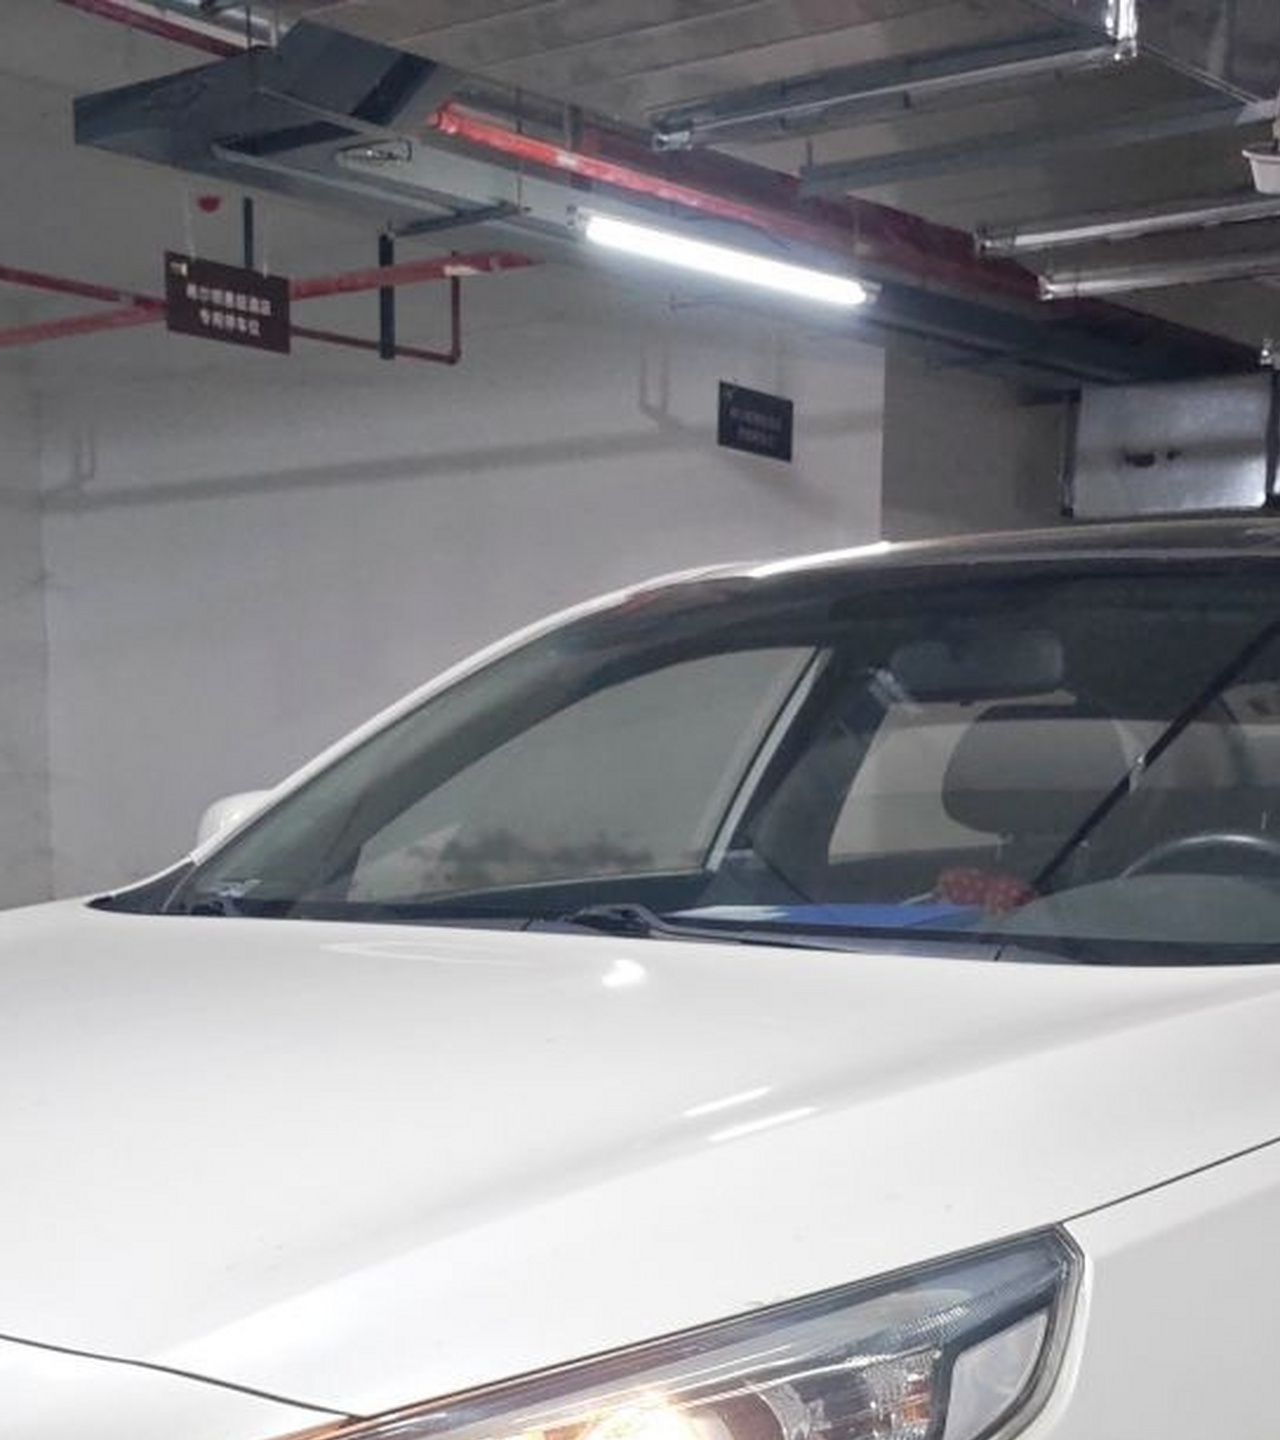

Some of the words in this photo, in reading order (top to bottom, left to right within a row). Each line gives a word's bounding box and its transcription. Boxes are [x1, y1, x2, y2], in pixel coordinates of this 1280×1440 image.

[199, 308, 261, 338] 专用停车位
